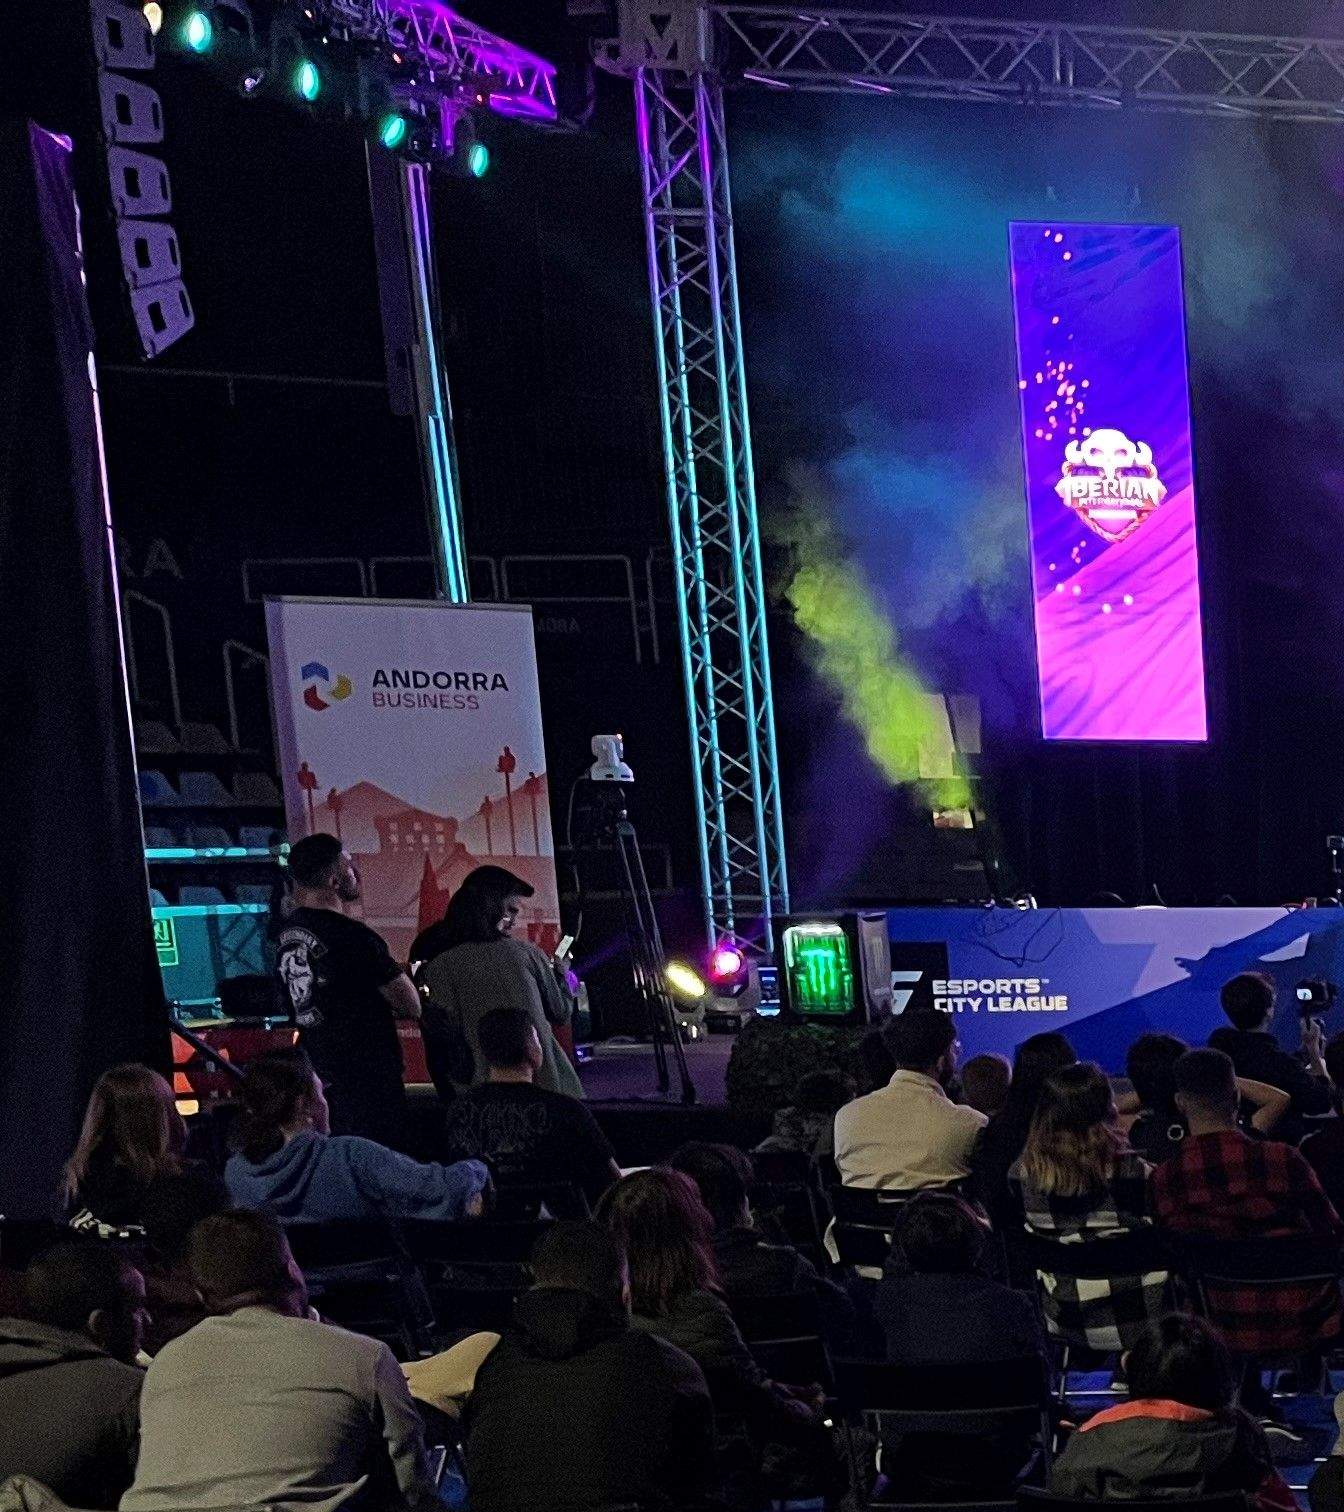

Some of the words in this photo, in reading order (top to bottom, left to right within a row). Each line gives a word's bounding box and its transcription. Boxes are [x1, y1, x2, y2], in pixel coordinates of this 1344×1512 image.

[1063, 476, 1160, 508] IBERIAN
[372, 669, 509, 692] ANDORRA
[372, 691, 480, 710] BUSINESS
[933, 997, 983, 1013] CITY
[987, 995, 1068, 1013] LEAGUE
